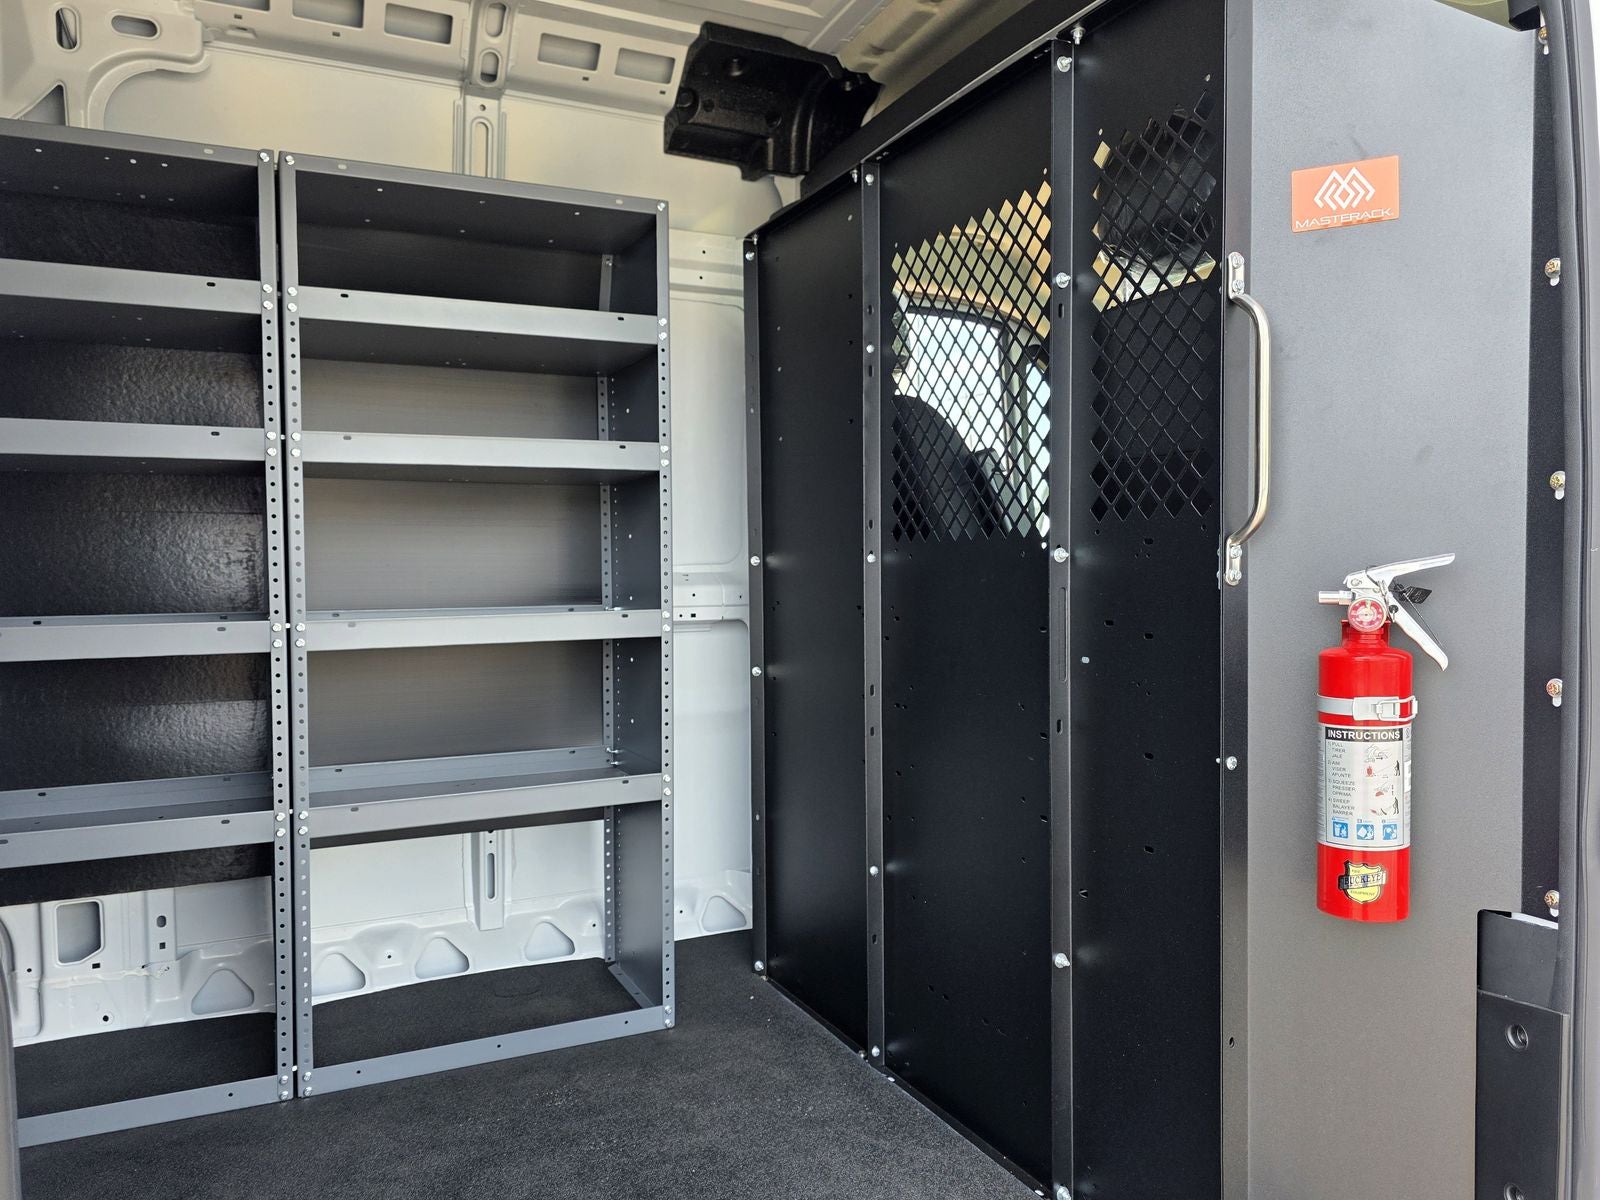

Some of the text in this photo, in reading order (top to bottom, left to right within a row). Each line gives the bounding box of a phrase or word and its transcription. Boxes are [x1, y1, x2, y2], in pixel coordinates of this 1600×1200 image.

[1295, 208, 1392, 229] MASTERACK
[1327, 729, 1400, 740] INSTRUCTIONS
[1344, 873, 1382, 885] BUCKEYE
